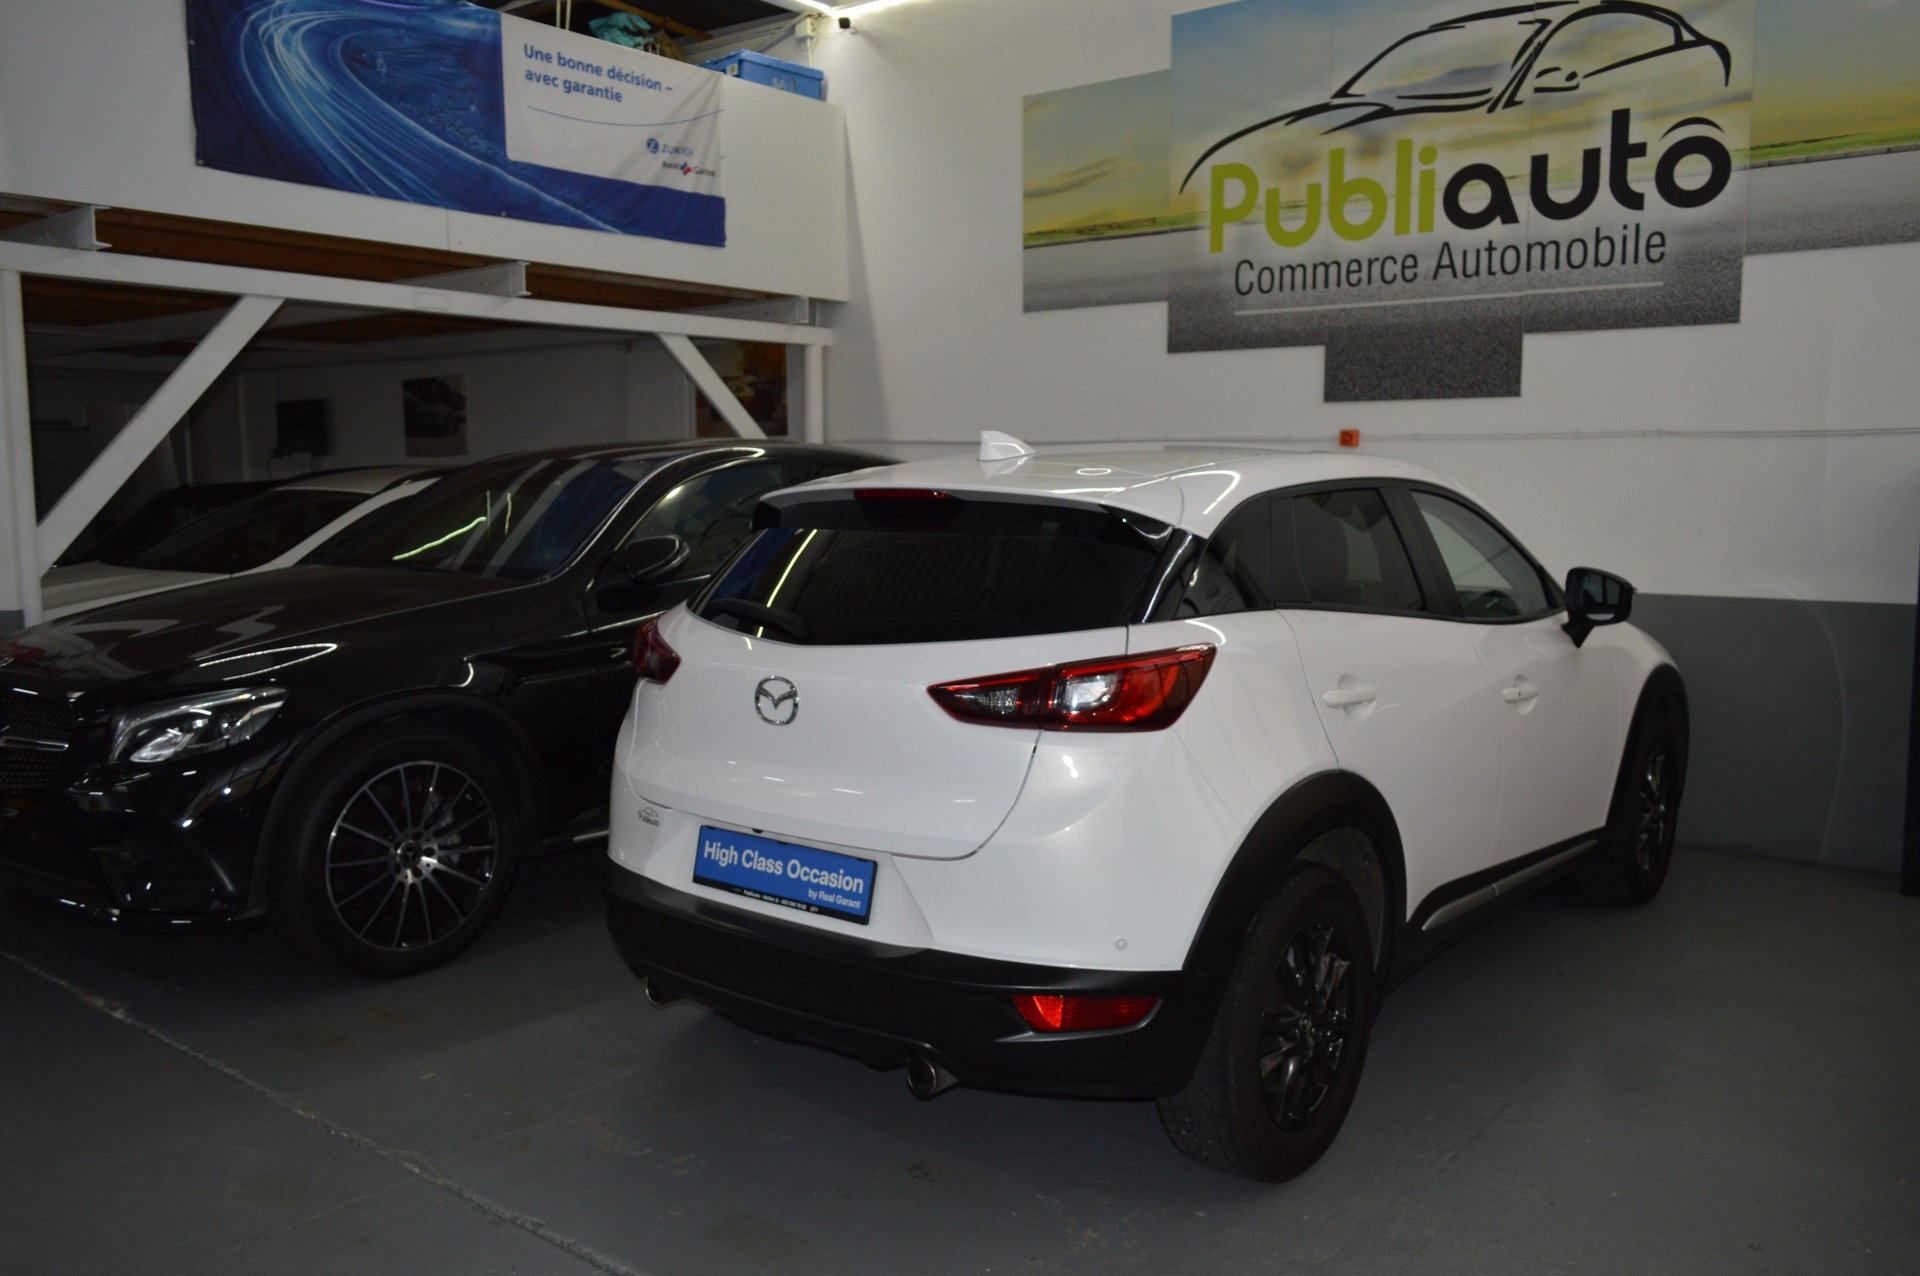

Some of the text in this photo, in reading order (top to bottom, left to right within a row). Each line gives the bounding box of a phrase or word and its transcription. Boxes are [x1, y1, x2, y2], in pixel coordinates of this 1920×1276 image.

[523, 43, 553, 63] Une
[557, 51, 603, 77] bonne
[607, 65, 662, 92] décision
[525, 69, 623, 103] avec garantie
[1234, 223, 1667, 296] Commerce Automobile
[703, 840, 864, 894] High Class Occasion
[807, 887, 818, 901] by
[818, 890, 836, 904] Real
[835, 894, 861, 909] Garant
